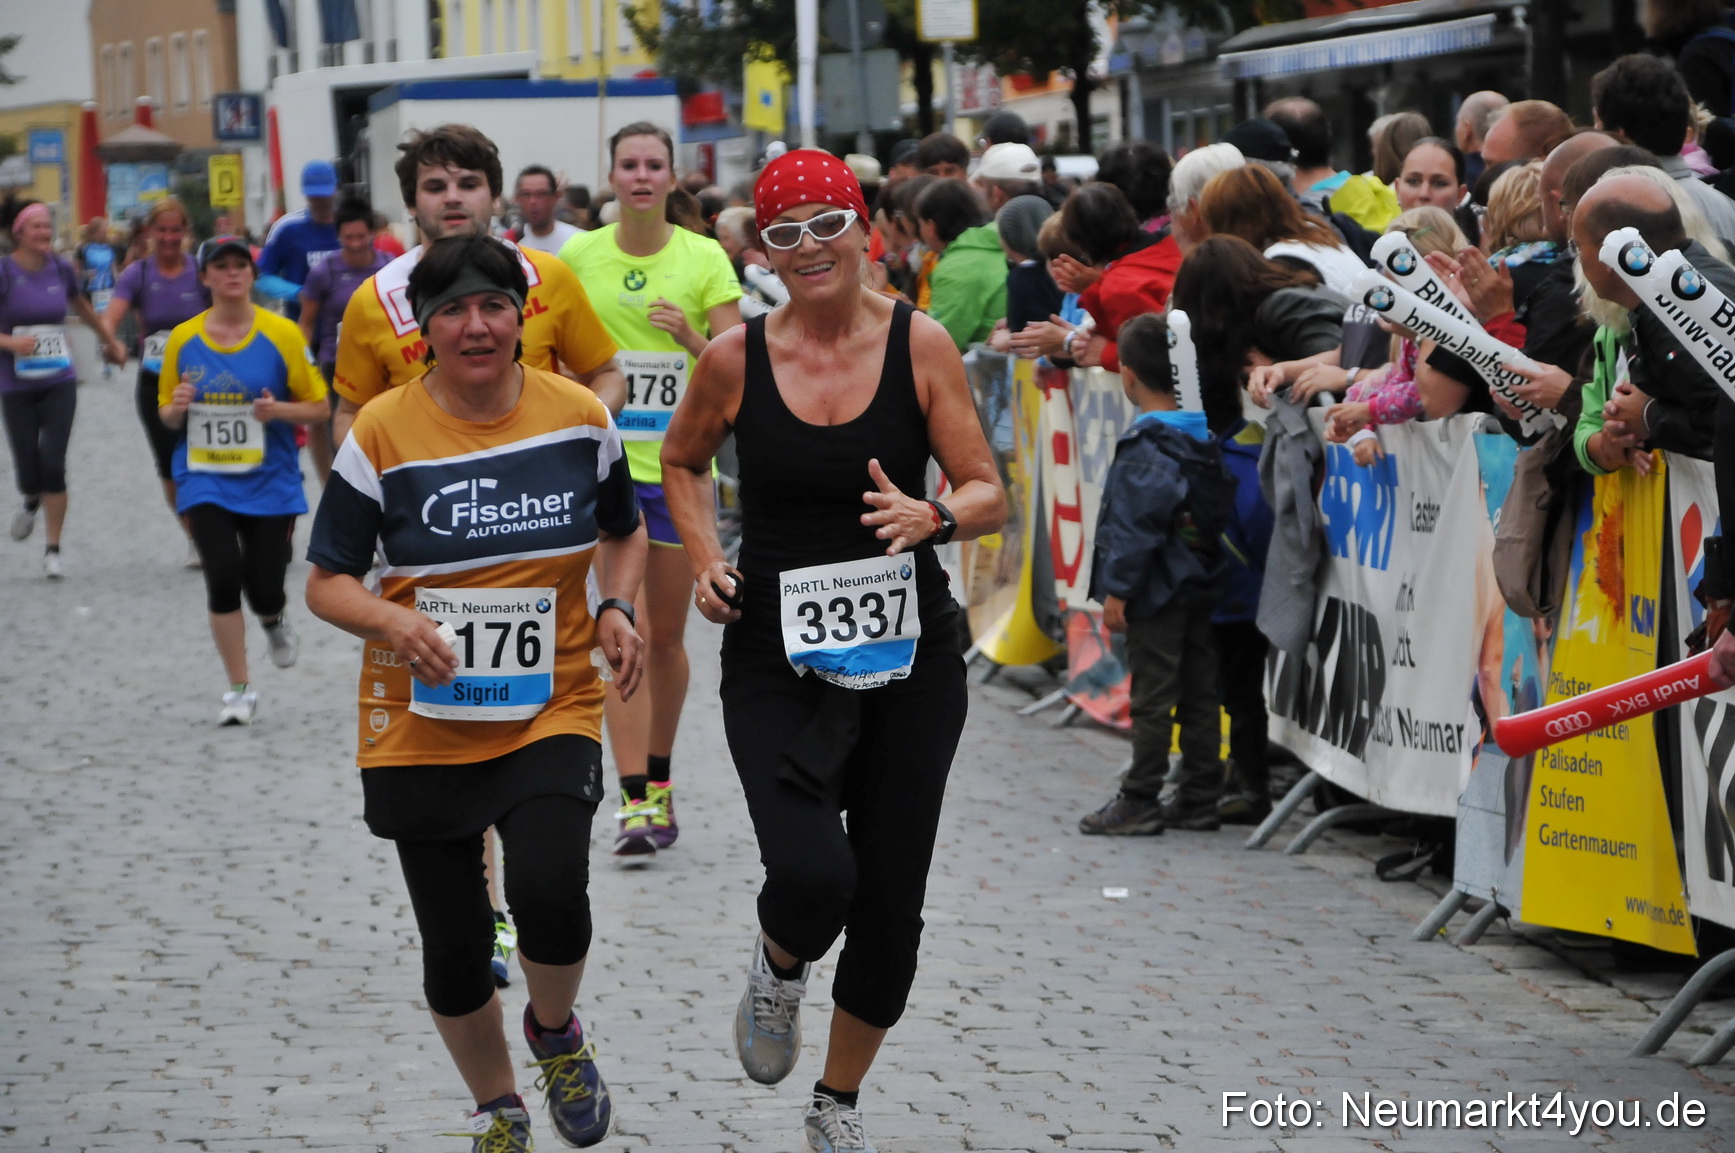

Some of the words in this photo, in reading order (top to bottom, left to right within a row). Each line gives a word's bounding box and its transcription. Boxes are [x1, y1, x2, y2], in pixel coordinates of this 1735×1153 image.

[201, 419, 248, 446] 150
[451, 491, 575, 527] Fischer
[465, 514, 572, 540] AUTOMOBILE
[783, 579, 830, 597] PARTL
[833, 569, 898, 590] Neumarkt
[462, 601, 531, 614] Neumarkt
[796, 587, 908, 645] 3337
[434, 620, 541, 669] 176
[453, 682, 510, 706] Sigrid
[1652, 674, 1701, 703] Audi
[1606, 691, 1651, 718] BKK
[1541, 747, 1604, 777] Palisaden
[1540, 784, 1585, 813] Stufen
[1538, 822, 1638, 861] Gartenmauern
